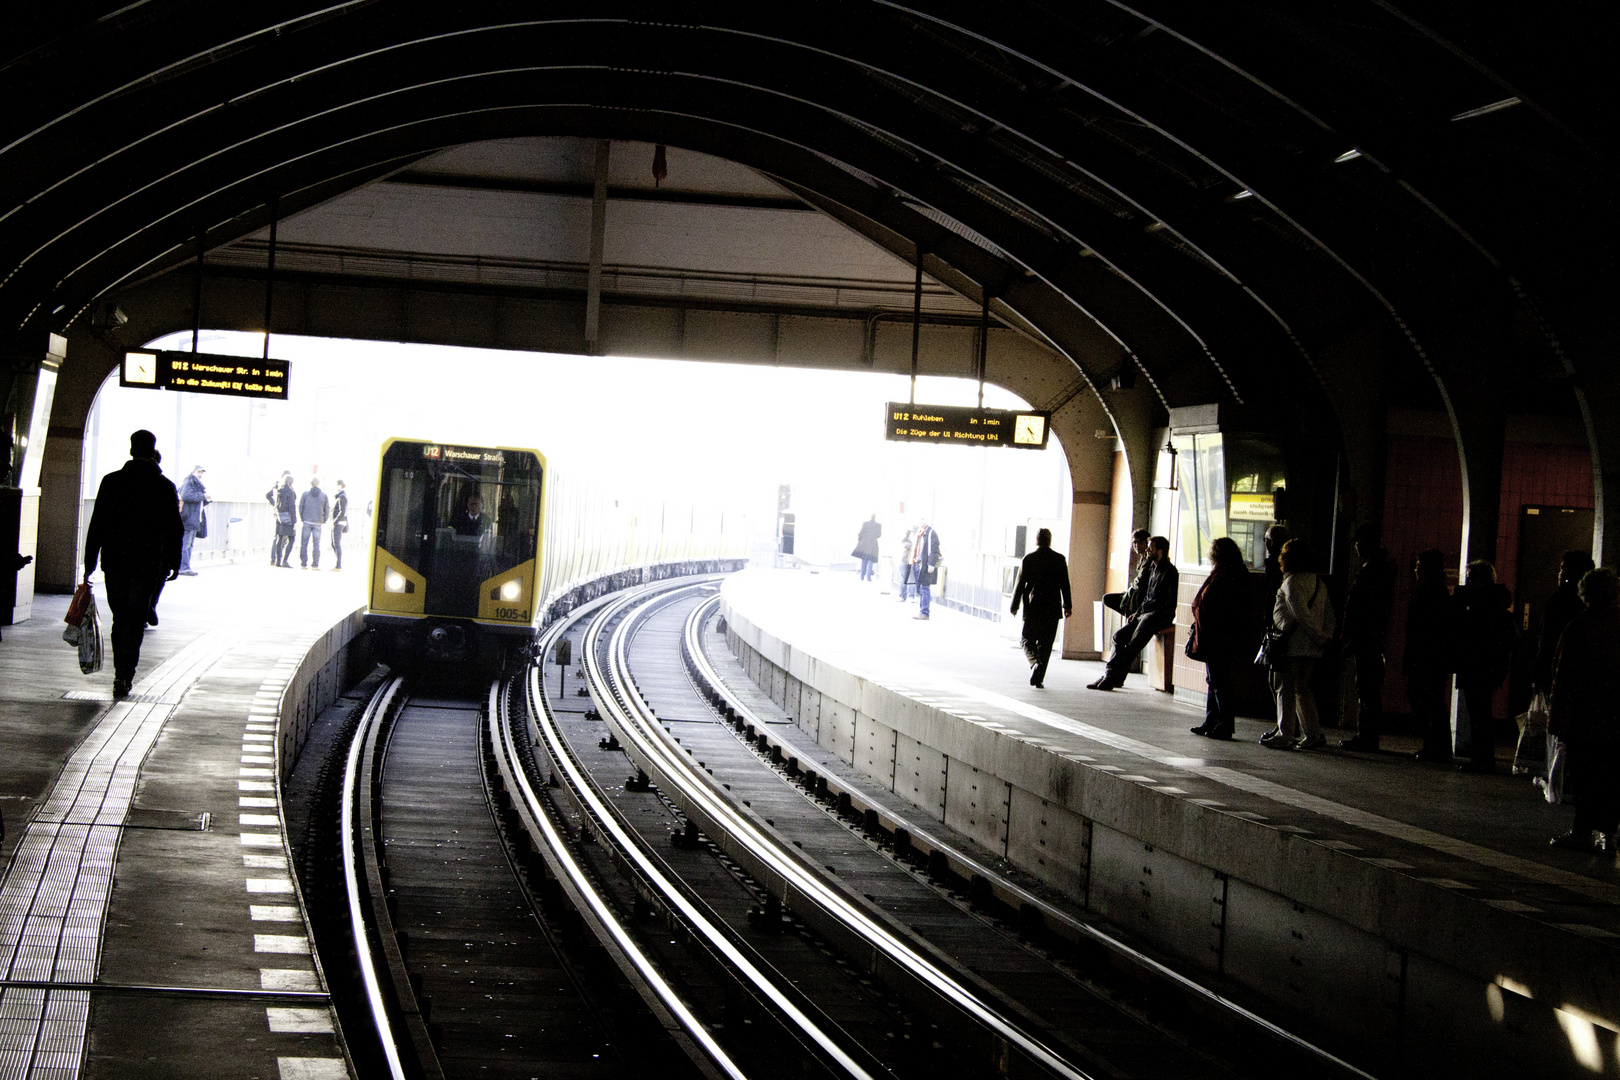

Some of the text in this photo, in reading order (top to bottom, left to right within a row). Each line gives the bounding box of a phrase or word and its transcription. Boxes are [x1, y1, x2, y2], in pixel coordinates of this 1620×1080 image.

[171, 361, 189, 371] U12
[192, 363, 234, 373] Warschauer
[235, 366, 249, 375] Str.
[252, 368, 260, 376] in
[186, 378, 200, 386] die
[244, 383, 264, 392] tolle
[893, 412, 910, 421] U12
[912, 413, 944, 422] Ruhleben
[969, 417, 978, 425] in
[943, 430, 951, 438] U1
[953, 431, 986, 441] Richtung
[423, 445, 440, 457] U12
[444, 449, 481, 461] Warschauer
[495, 608, 527, 619] 1005-4
